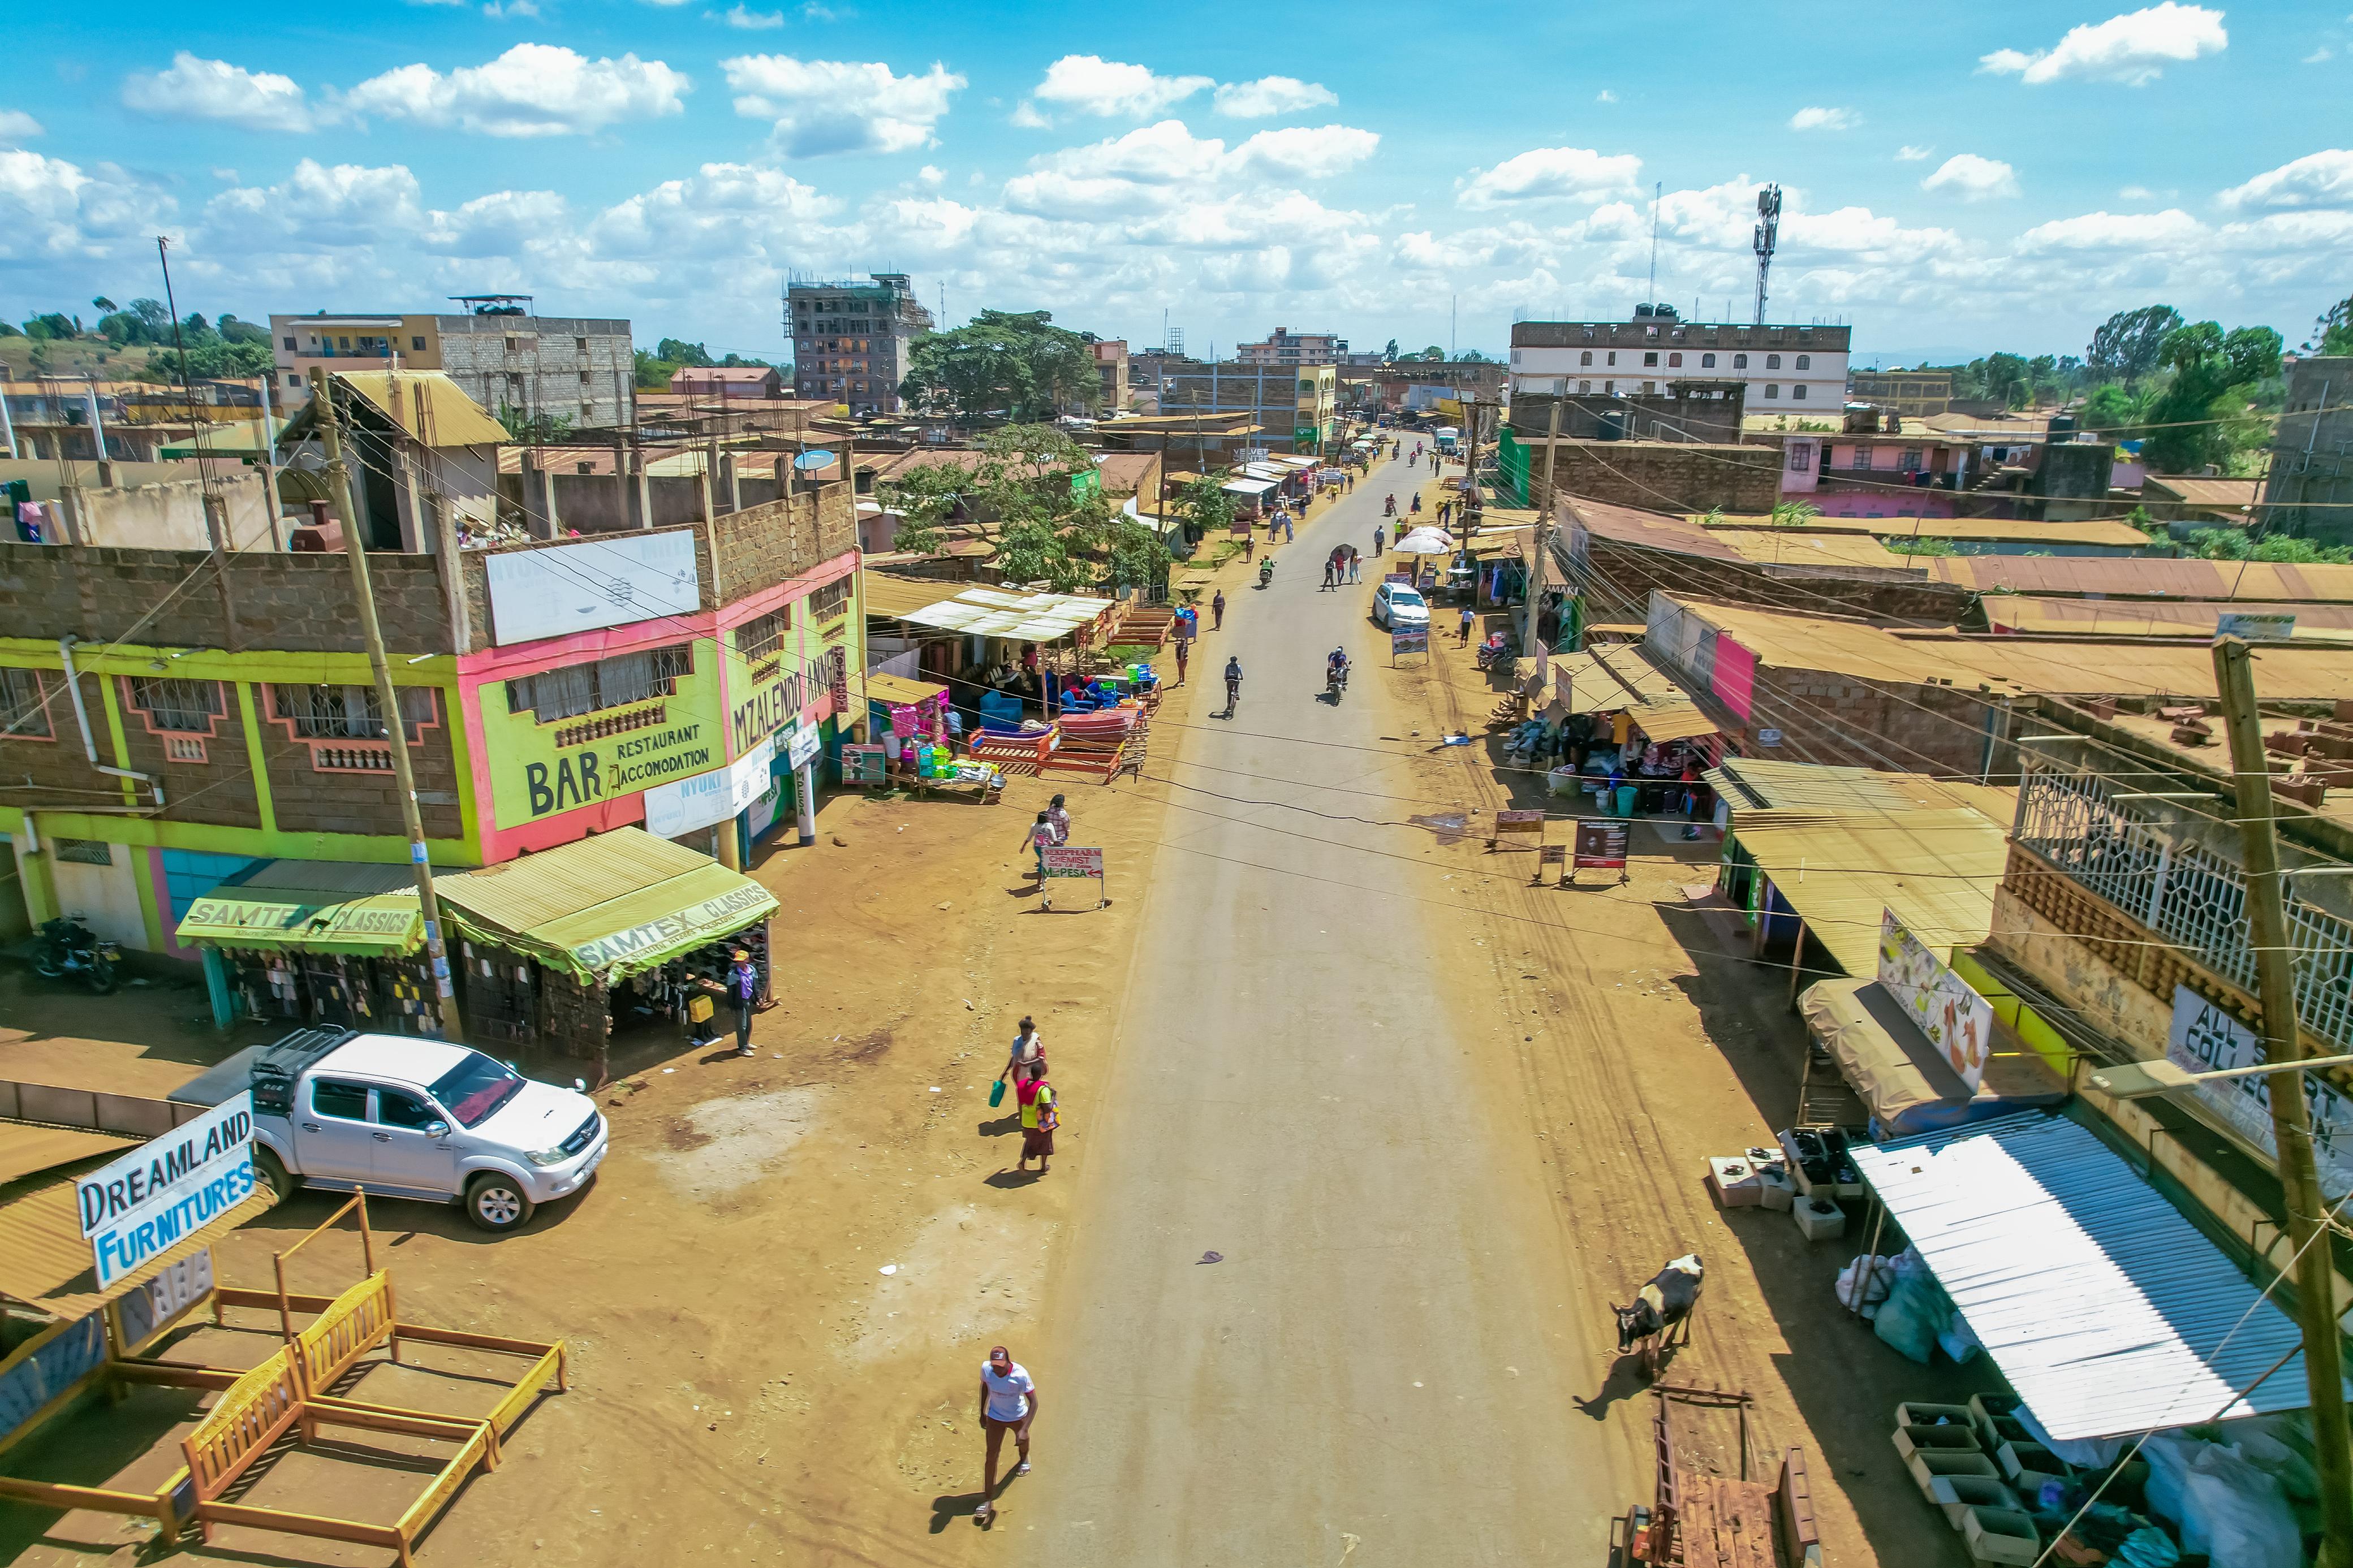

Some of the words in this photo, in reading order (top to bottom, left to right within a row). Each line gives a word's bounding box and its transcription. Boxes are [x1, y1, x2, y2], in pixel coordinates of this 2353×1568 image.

[1546, 585, 1579, 595] AMAKI
[734, 671, 801, 756] MZALENDO
[618, 724, 700, 759] RESTAURANT
[525, 751, 603, 816] BAR
[619, 748, 709, 785] ACCOMODATION
[681, 772, 722, 798] NYUKI
[796, 771, 806, 817] MPESA
[195, 903, 315, 928] SAMTEX
[334, 909, 410, 932] CLASSICS
[578, 911, 697, 967] SAMTEX
[703, 884, 769, 919] CLASSICS
[2196, 1005, 2238, 1049] ALL
[80, 1110, 251, 1231] DREAMLAND
[97, 1160, 256, 1284] FURNITURES
